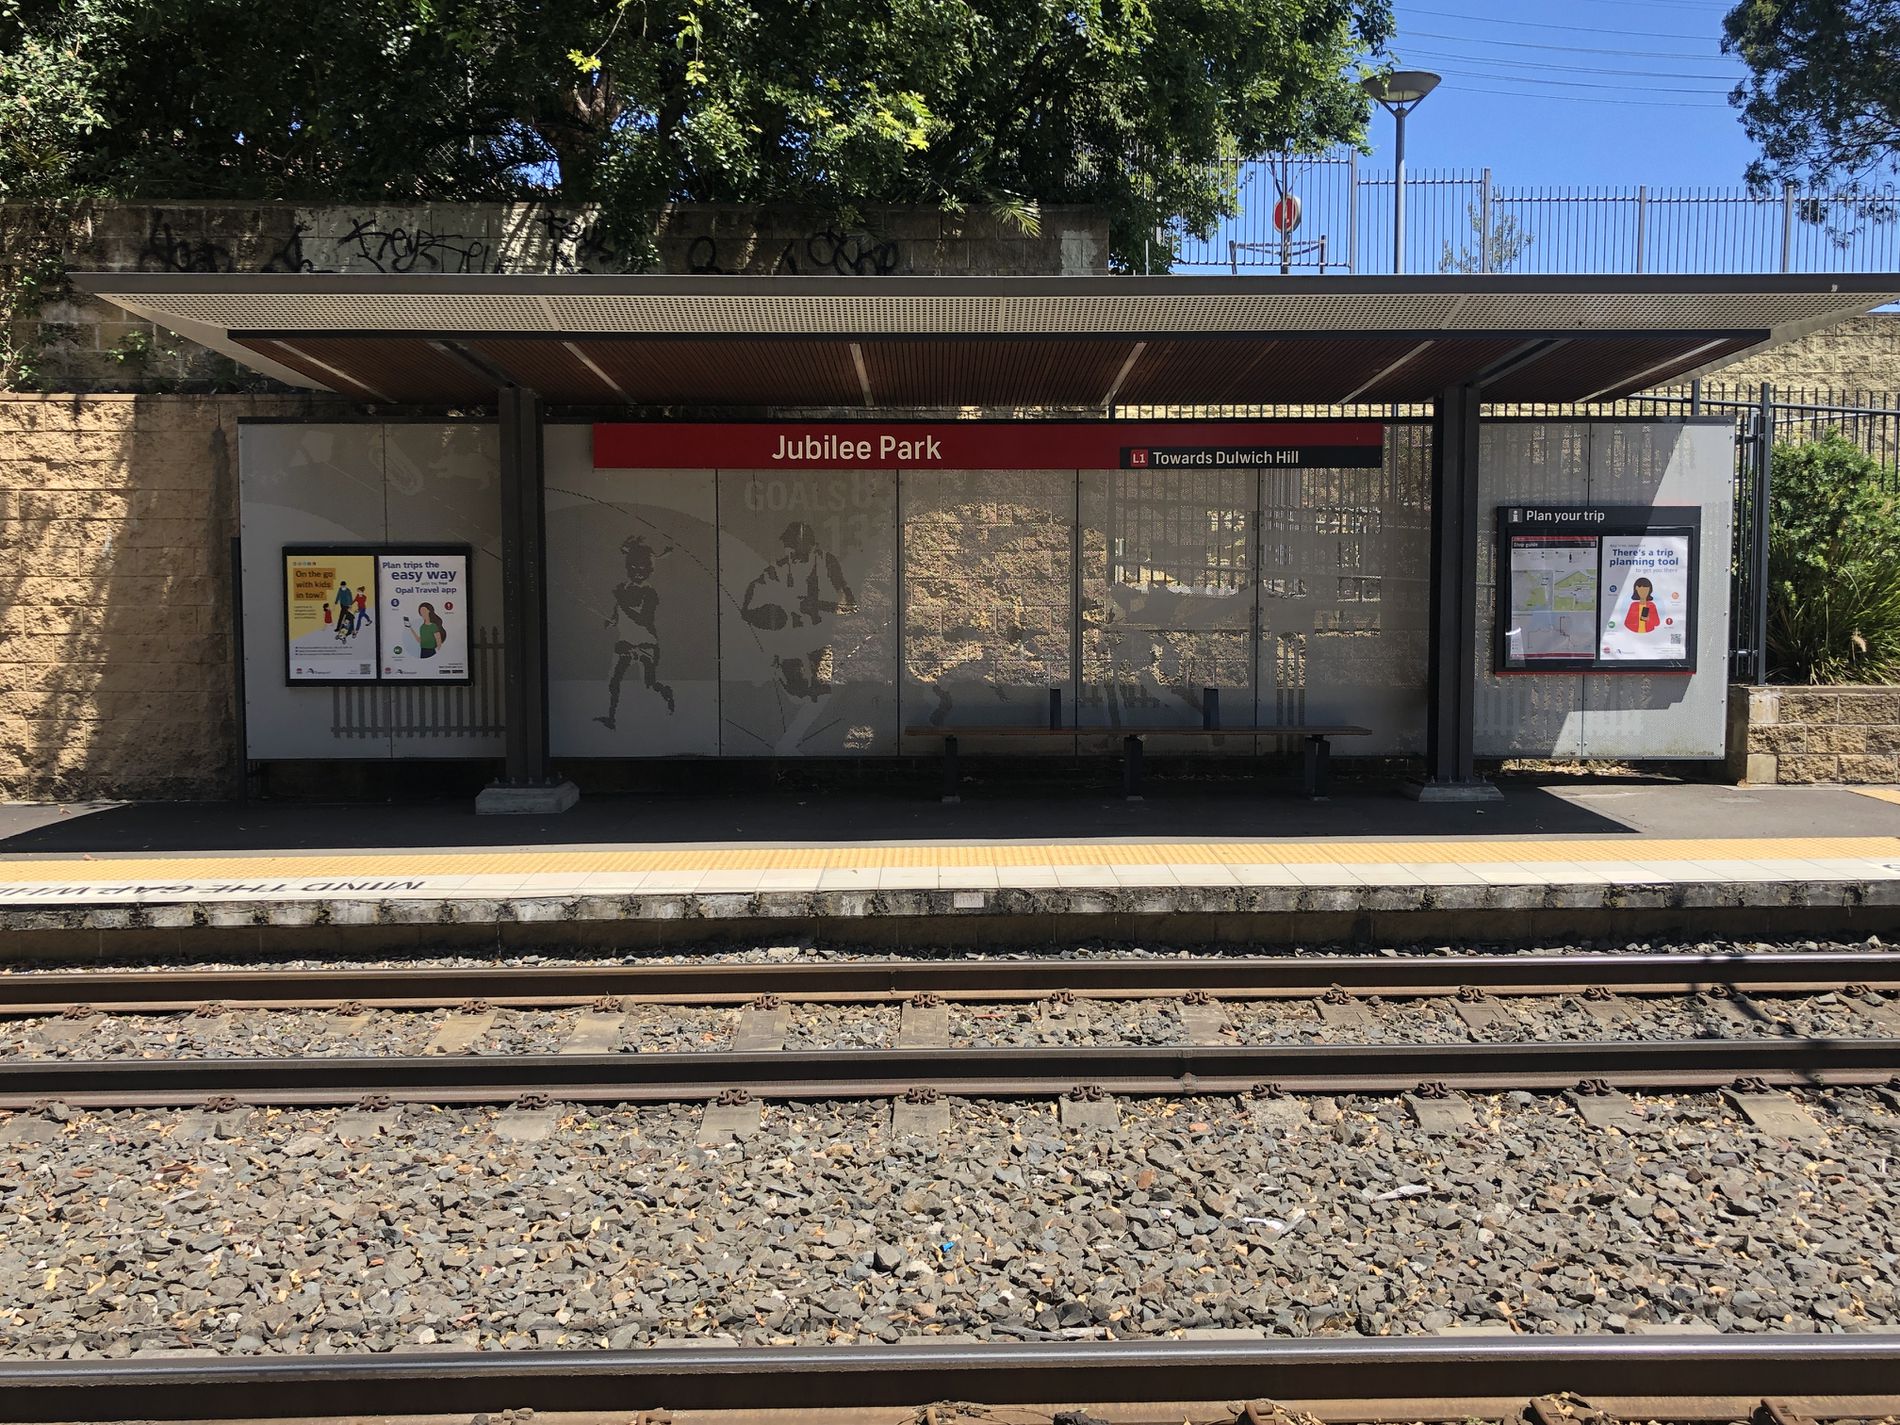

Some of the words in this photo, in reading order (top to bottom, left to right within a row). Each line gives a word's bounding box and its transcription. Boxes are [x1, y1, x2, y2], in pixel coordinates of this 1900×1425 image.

[771, 434, 872, 460] Jubilee
[879, 434, 942, 460] Park
[1132, 453, 1146, 464] L1
[1152, 451, 1213, 465] Towards
[1215, 450, 1273, 464] Dulwich
[1275, 450, 1299, 464] Hill
[744, 480, 848, 512] GOALS
[1526, 510, 1552, 521] Plan
[1554, 512, 1582, 524] your
[1583, 510, 1605, 523] trip
[1612, 548, 1646, 557] There's
[1656, 548, 1674, 558] trip
[382, 561, 401, 569] Plan
[403, 560, 423, 570] trips
[424, 560, 440, 569] the
[1609, 557, 1655, 568] planning
[1657, 557, 1679, 566] tool
[295, 570, 307, 578] On
[308, 570, 321, 578] the
[322, 571, 334, 580] go
[391, 570, 423, 583] easy
[426, 570, 457, 583] way
[295, 580, 313, 589] with
[314, 580, 331, 589] kids
[395, 586, 414, 595] Opal
[415, 585, 440, 594] Travel
[441, 586, 457, 595] app
[296, 591, 304, 599] in
[305, 591, 325, 599] tow?
[97, 885, 194, 895] GAP
[198, 883, 288, 894] THE
[300, 881, 426, 892] MIND
